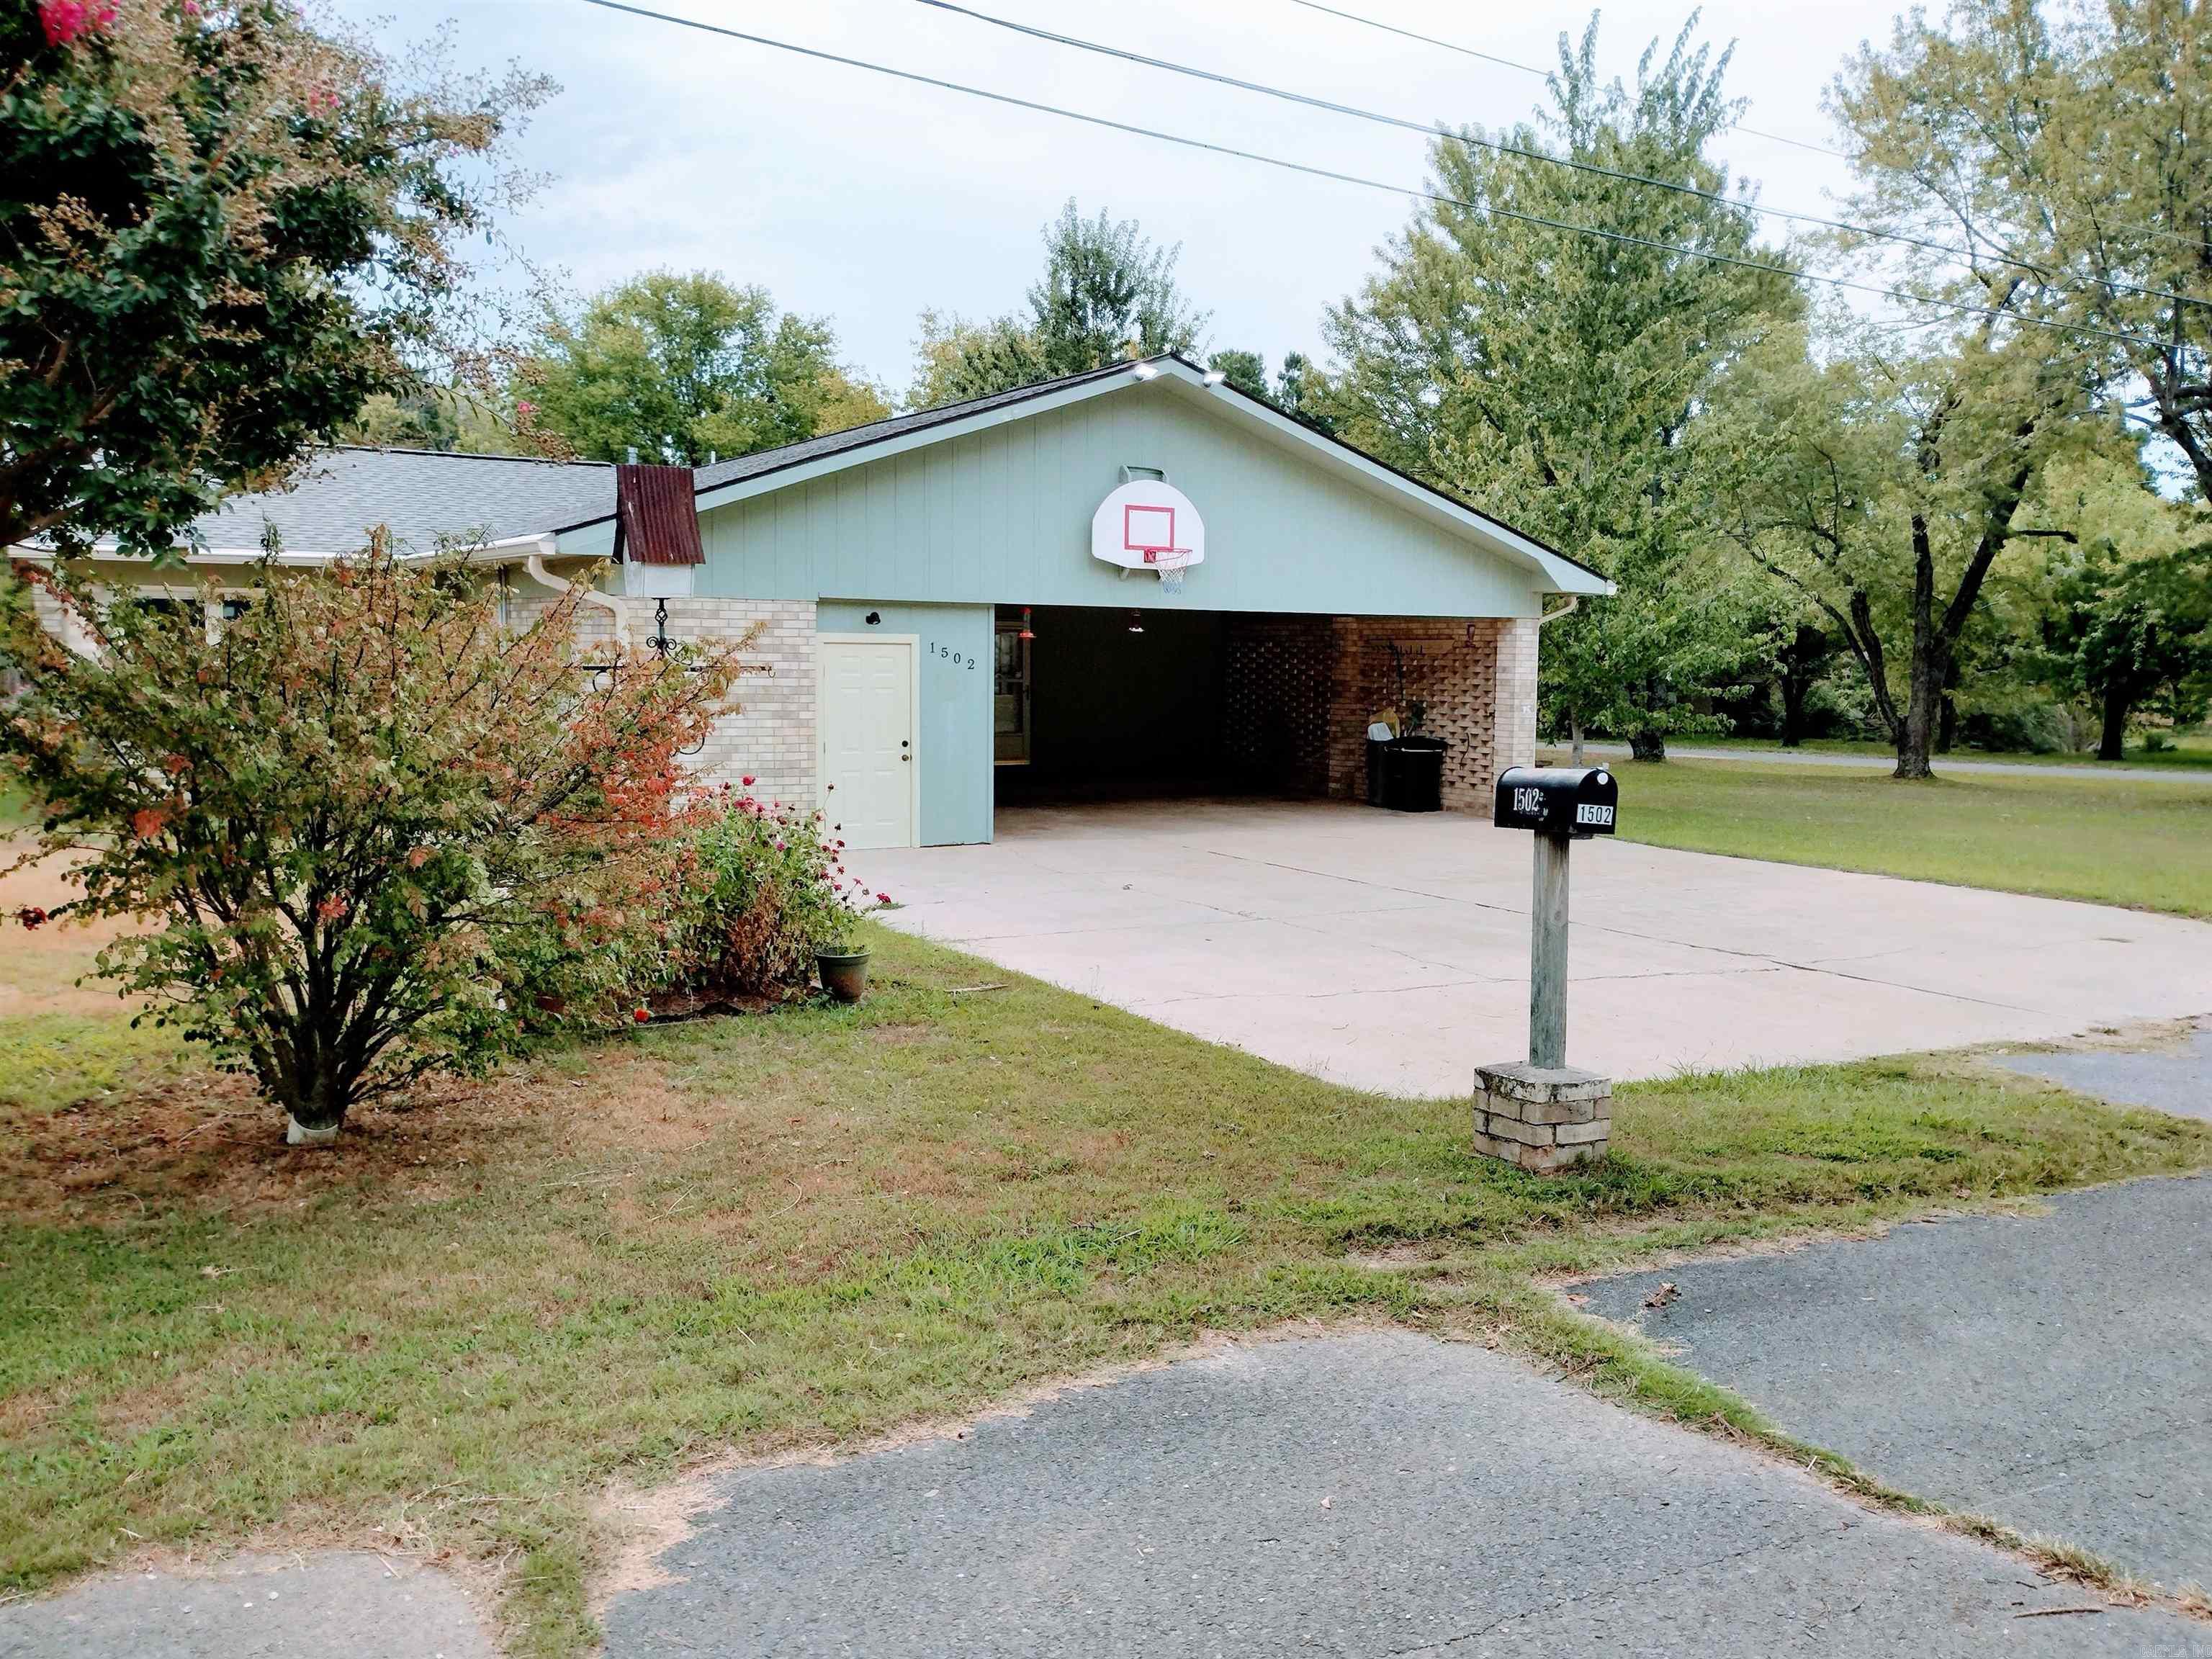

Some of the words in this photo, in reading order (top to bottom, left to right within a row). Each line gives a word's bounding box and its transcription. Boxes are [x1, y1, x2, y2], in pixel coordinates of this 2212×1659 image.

[930, 642, 975, 670] 1502
[1513, 787, 1540, 811] 1502
[1581, 806, 1611, 824] 1502
